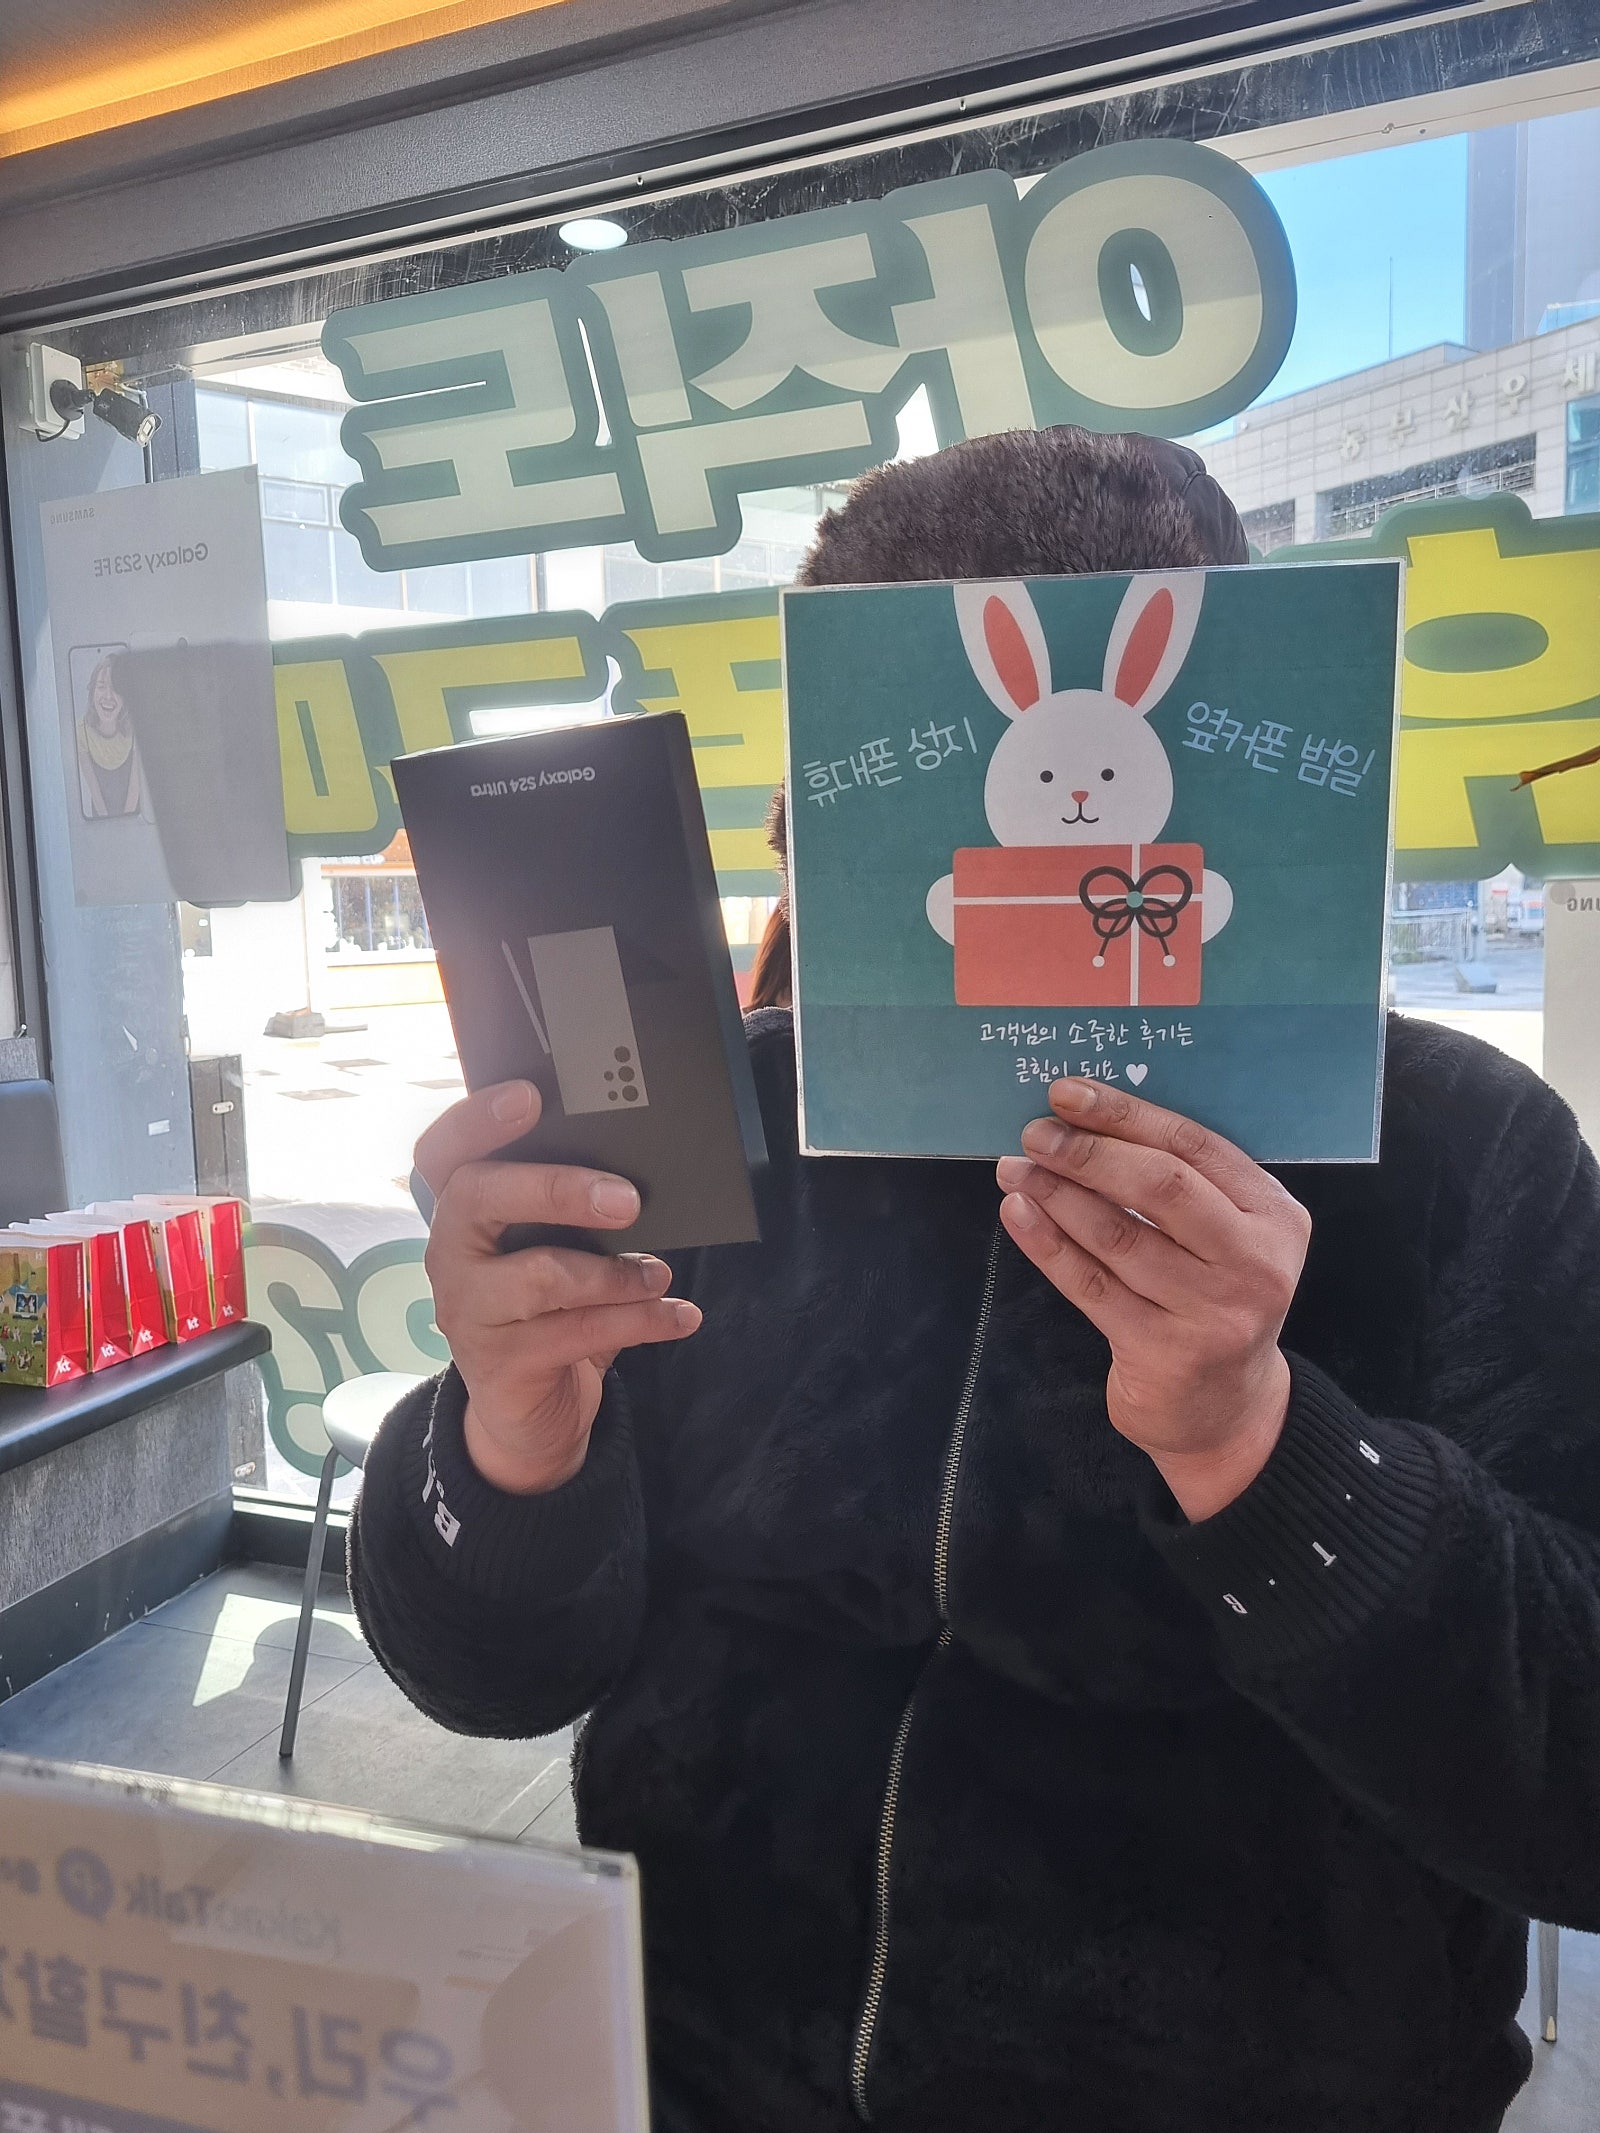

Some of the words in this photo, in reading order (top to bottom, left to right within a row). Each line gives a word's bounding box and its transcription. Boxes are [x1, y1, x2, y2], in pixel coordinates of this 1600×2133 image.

[802, 736, 903, 808] 휴대폰
[907, 715, 978, 771] 성지
[1181, 701, 1294, 774] 옆커폰
[1297, 733, 1376, 798] 범일
[470, 780, 508, 797] Ultra
[509, 776, 537, 794] S24
[538, 766, 596, 787] Galaxy
[980, 1021, 1057, 1047] 고객님의
[1068, 1018, 1130, 1052] 소중한
[1139, 1017, 1194, 1050] 후기는
